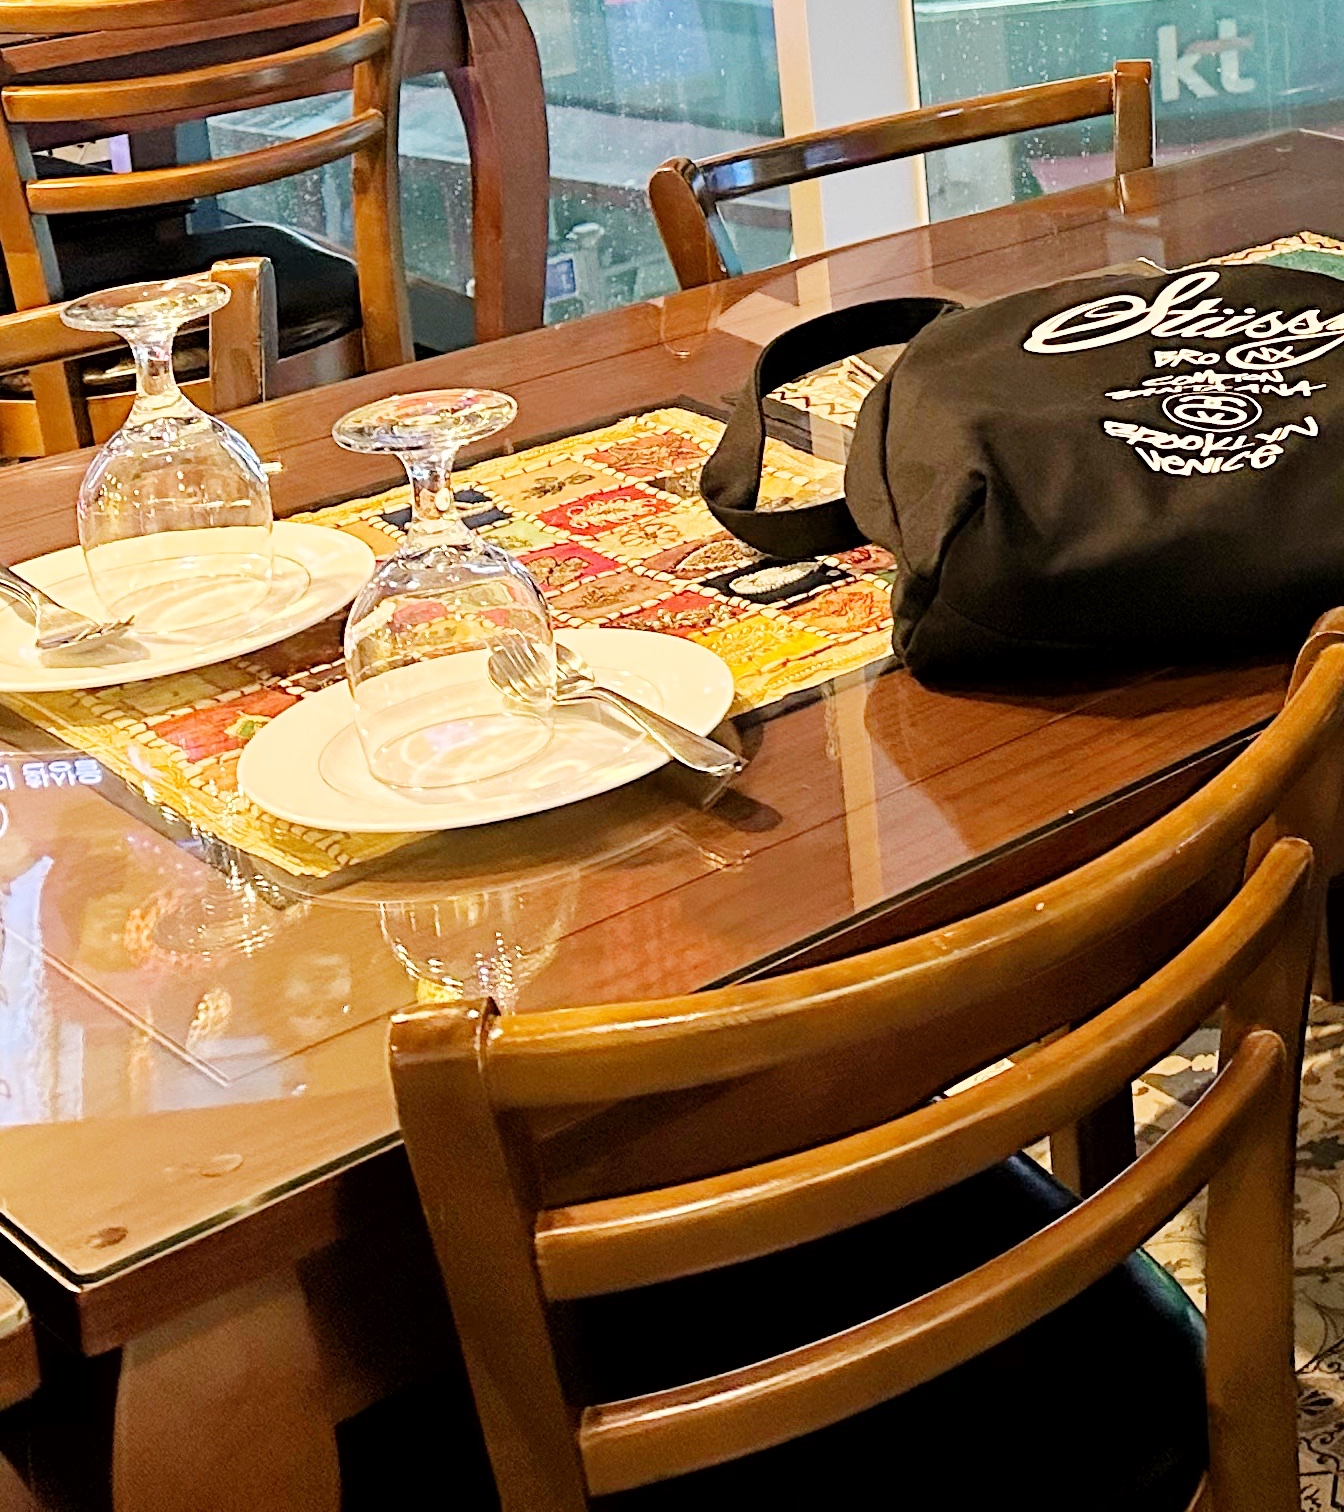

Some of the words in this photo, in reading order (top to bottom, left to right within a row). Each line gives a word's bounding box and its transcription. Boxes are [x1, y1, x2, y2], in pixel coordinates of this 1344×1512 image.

[1157, 18, 1257, 103] kt
[1103, 416, 1319, 456] BROOKLYN
[1135, 441, 1284, 476] VENICE
